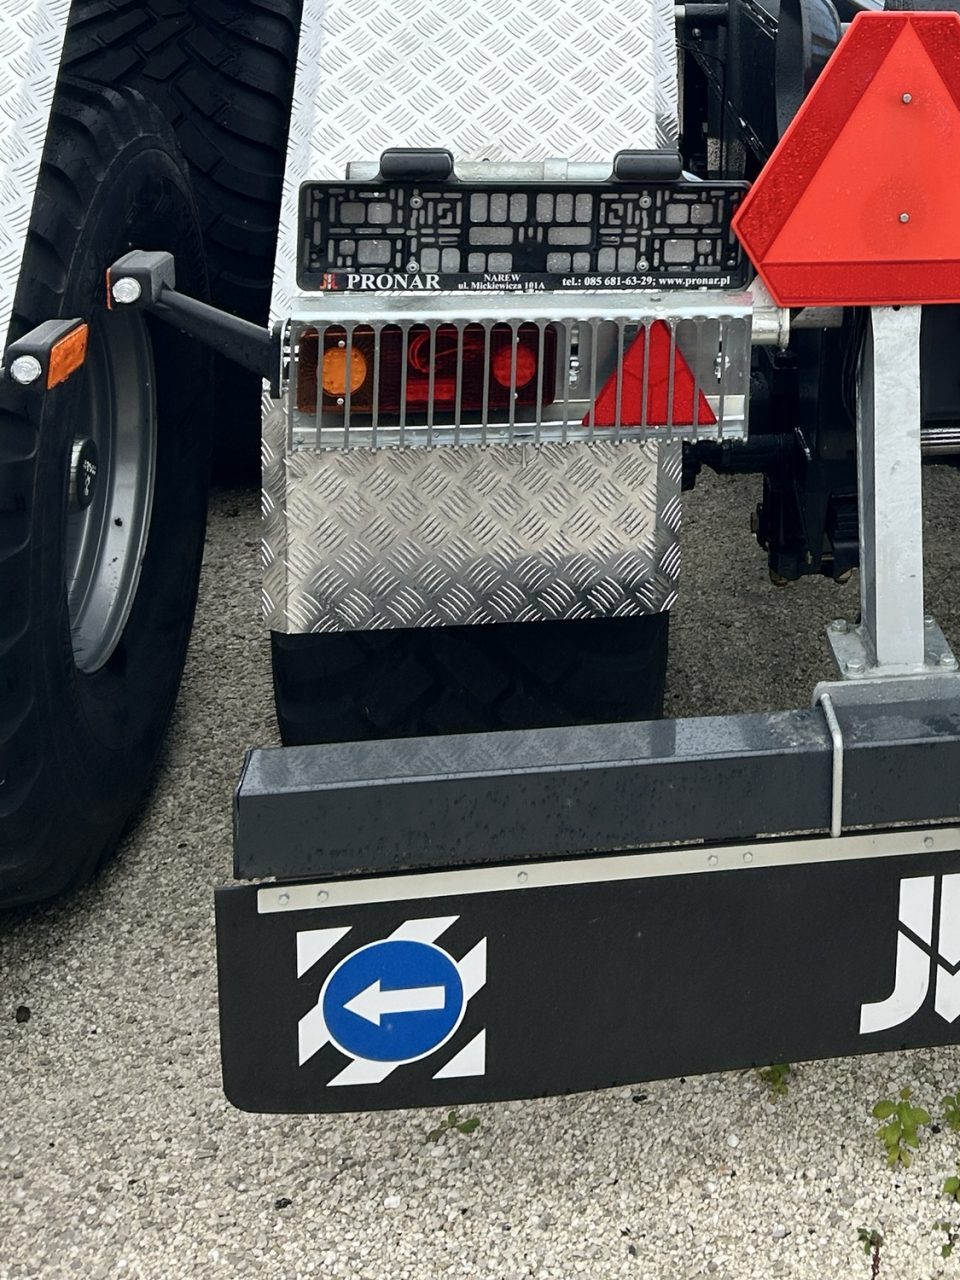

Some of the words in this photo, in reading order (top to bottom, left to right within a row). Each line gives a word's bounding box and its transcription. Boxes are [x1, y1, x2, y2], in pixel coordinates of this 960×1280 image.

[346, 274, 441, 290] PRONAR
[483, 273, 521, 282] NAREW
[562, 276, 582, 286] tel.:
[584, 276, 602, 286] 085
[604, 276, 656, 287] 681-63-29;
[659, 276, 731, 287] www.pronar.pl
[458, 282, 469, 290] ul.
[471, 282, 522, 290] Mickiewicza
[525, 281, 545, 290] 101A
